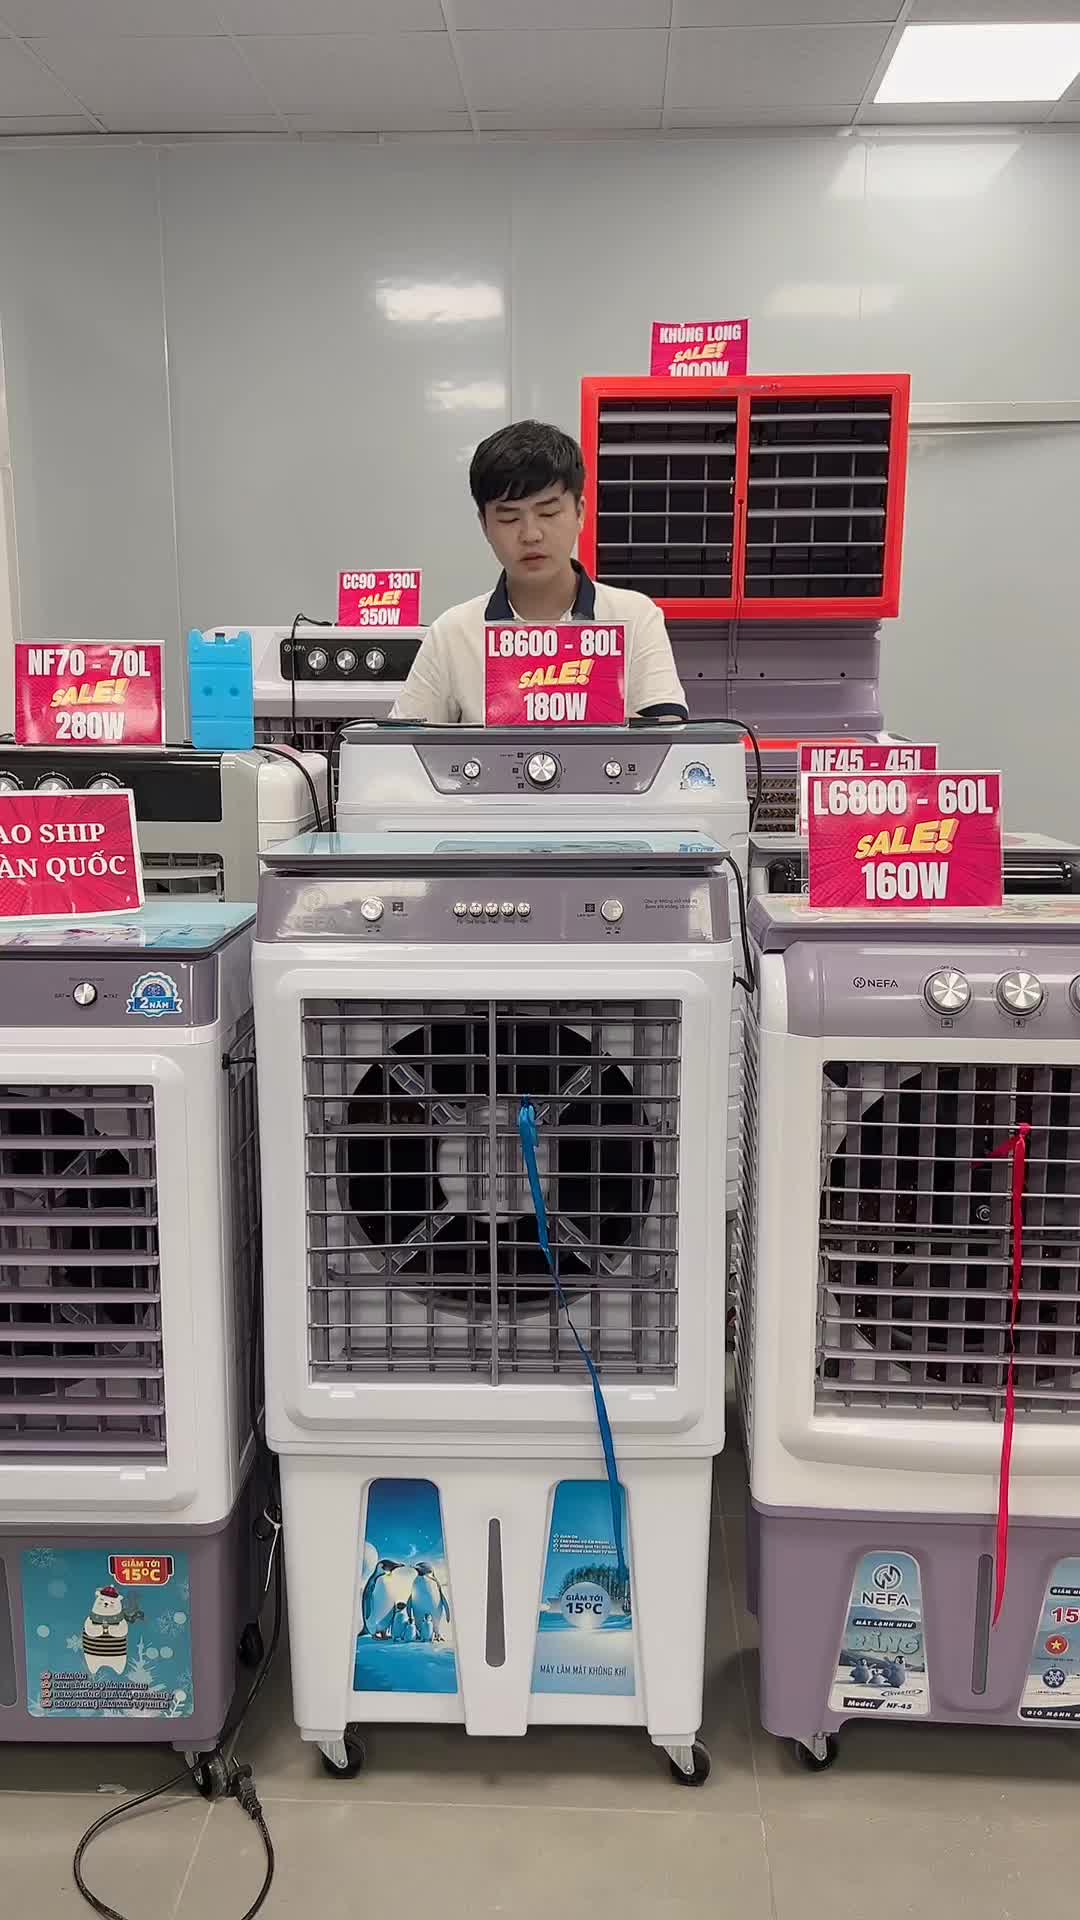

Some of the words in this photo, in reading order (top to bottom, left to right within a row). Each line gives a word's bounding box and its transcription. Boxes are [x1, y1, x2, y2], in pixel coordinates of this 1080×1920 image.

[659, 323, 703, 344] KHỦNG
[707, 325, 741, 342] LONG
[673, 341, 728, 362] SALE!
[668, 361, 730, 376] 1000W
[343, 573, 376, 589] CC90
[388, 573, 417, 589] 130L
[358, 590, 402, 608] SALE!
[360, 608, 400, 625] 350W
[488, 630, 558, 657] L8600
[580, 629, 622, 656] 80L
[28, 649, 85, 676] NF70
[108, 650, 151, 677] 70L
[518, 659, 595, 689] SALE!
[50, 678, 130, 707] SALE!
[524, 692, 588, 721] 180W
[55, 711, 125, 740] 280W
[810, 749, 864, 771] NF45
[813, 780, 907, 815] L6800
[938, 779, 993, 814] 60L
[39, 823, 105, 843] SHIP
[854, 818, 960, 859] SALE!
[46, 850, 127, 882] QUỐC
[861, 861, 948, 900] 160W
[867, 980, 898, 988] NEFA
[140, 997, 149, 1009] 2
[149, 1000, 169, 1009] NĂM
[121, 1559, 144, 1568] GIẢM
[145, 1559, 160, 1568] TỚI
[566, 1593, 587, 1602] GIẢM
[590, 1594, 603, 1602] TỚI
[861, 1592, 909, 1607] NEFA
[540, 1663, 555, 1674] MÁY
[588, 1664, 613, 1676] KHÔNG
